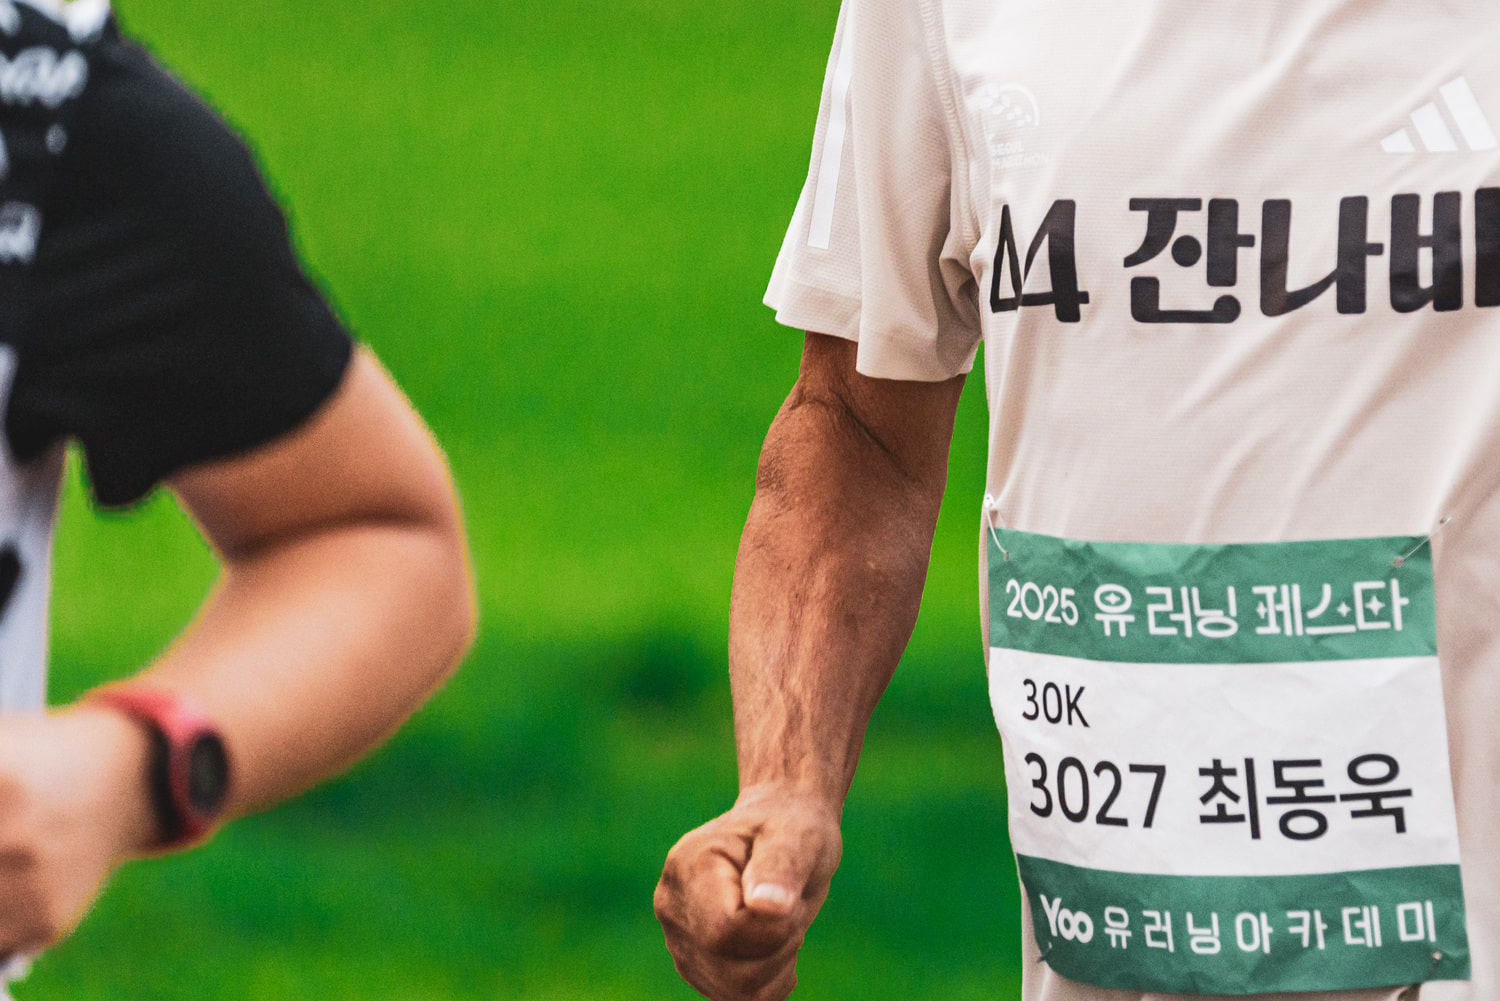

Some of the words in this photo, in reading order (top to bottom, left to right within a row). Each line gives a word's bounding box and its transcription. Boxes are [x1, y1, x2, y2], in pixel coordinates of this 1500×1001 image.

[1005, 578, 1079, 627] 2025
[1252, 578, 1410, 636] 페스타
[1021, 678, 1091, 729] 30K
[1023, 752, 1167, 829] 3027
[1197, 753, 1414, 842] 최동욱
